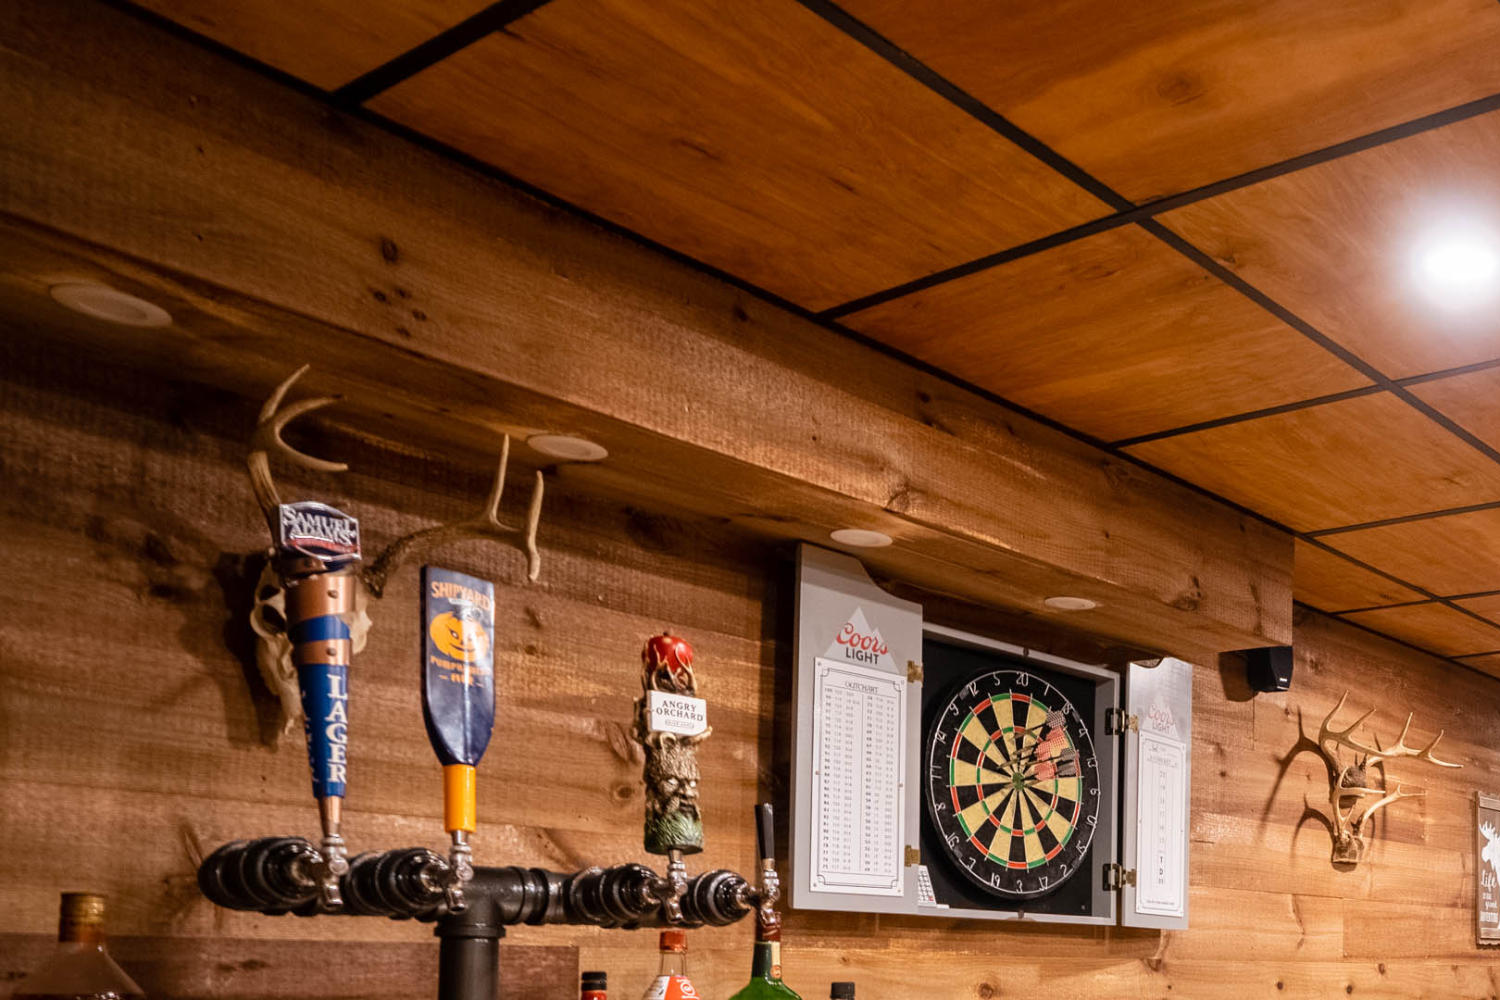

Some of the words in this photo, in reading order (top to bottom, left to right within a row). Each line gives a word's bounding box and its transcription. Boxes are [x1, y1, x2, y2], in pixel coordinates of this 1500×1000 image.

[283, 506, 350, 536] SAMUEL
[431, 581, 490, 611] SHIPYARD
[836, 622, 888, 655] Coors
[845, 647, 879, 664] LIGHT
[993, 672, 1000, 686] 5
[1016, 672, 1029, 687] 20
[968, 681, 979, 696] 12
[1044, 684, 1050, 696] 1
[662, 700, 697, 712] ANGRY
[656, 706, 704, 722] ORCHARD
[325, 673, 348, 784] LAGER
[967, 856, 976, 870] 7
[1060, 864, 1069, 878] 2
[991, 872, 1001, 888] 19
[1016, 880, 1023, 893] 3
[1039, 876, 1048, 891] 17
